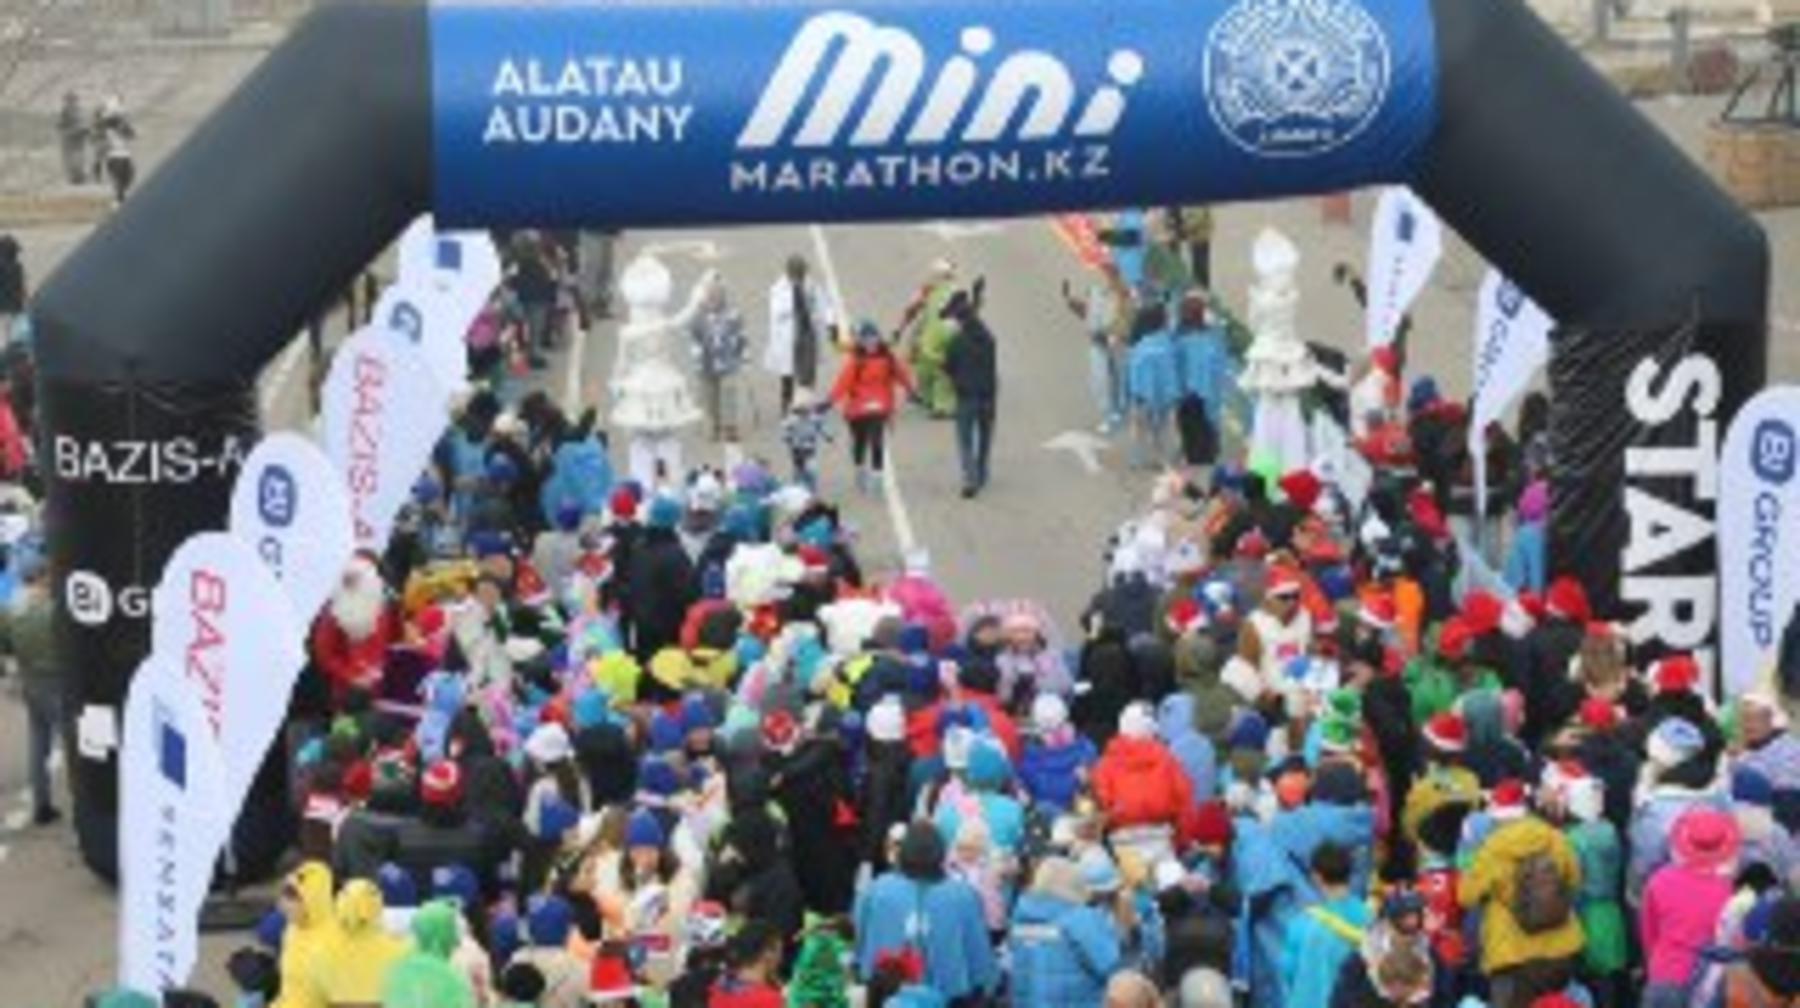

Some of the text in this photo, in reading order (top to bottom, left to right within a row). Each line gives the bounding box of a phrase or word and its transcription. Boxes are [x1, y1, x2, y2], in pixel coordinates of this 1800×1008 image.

[492, 57, 684, 96] ALATAU
[482, 105, 694, 143] AUDANY
[730, 146, 1111, 191] MARATHON.KZ
[1749, 493, 1780, 648] GROUP
